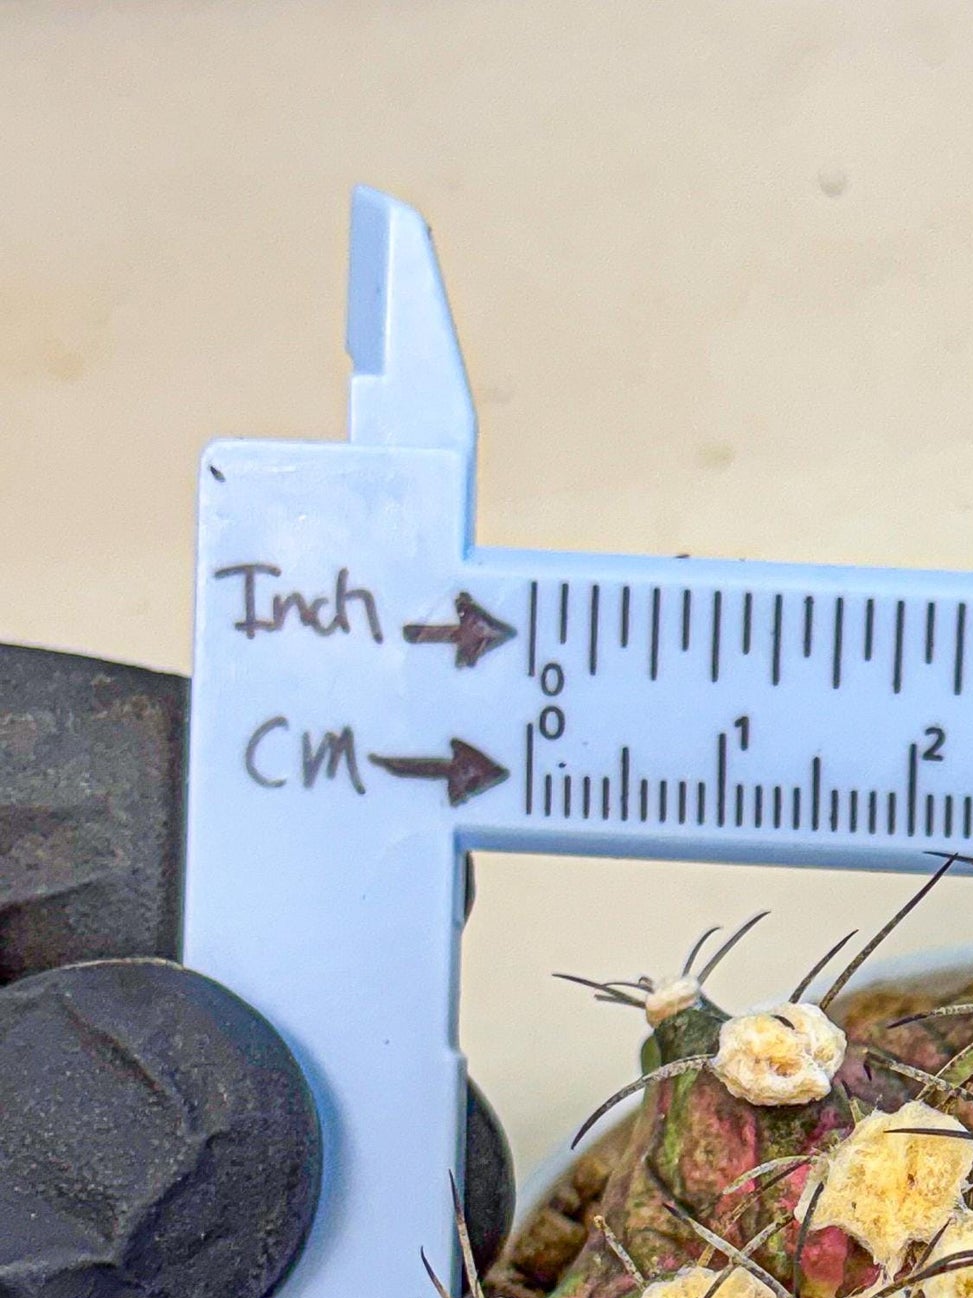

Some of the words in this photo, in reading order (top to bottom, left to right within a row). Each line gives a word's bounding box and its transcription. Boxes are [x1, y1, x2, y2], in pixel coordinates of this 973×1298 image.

[215, 563, 384, 644] Inch
[540, 662, 565, 697] 0
[539, 705, 566, 741] 0
[734, 716, 750, 751] 1
[921, 726, 946, 762] 2
